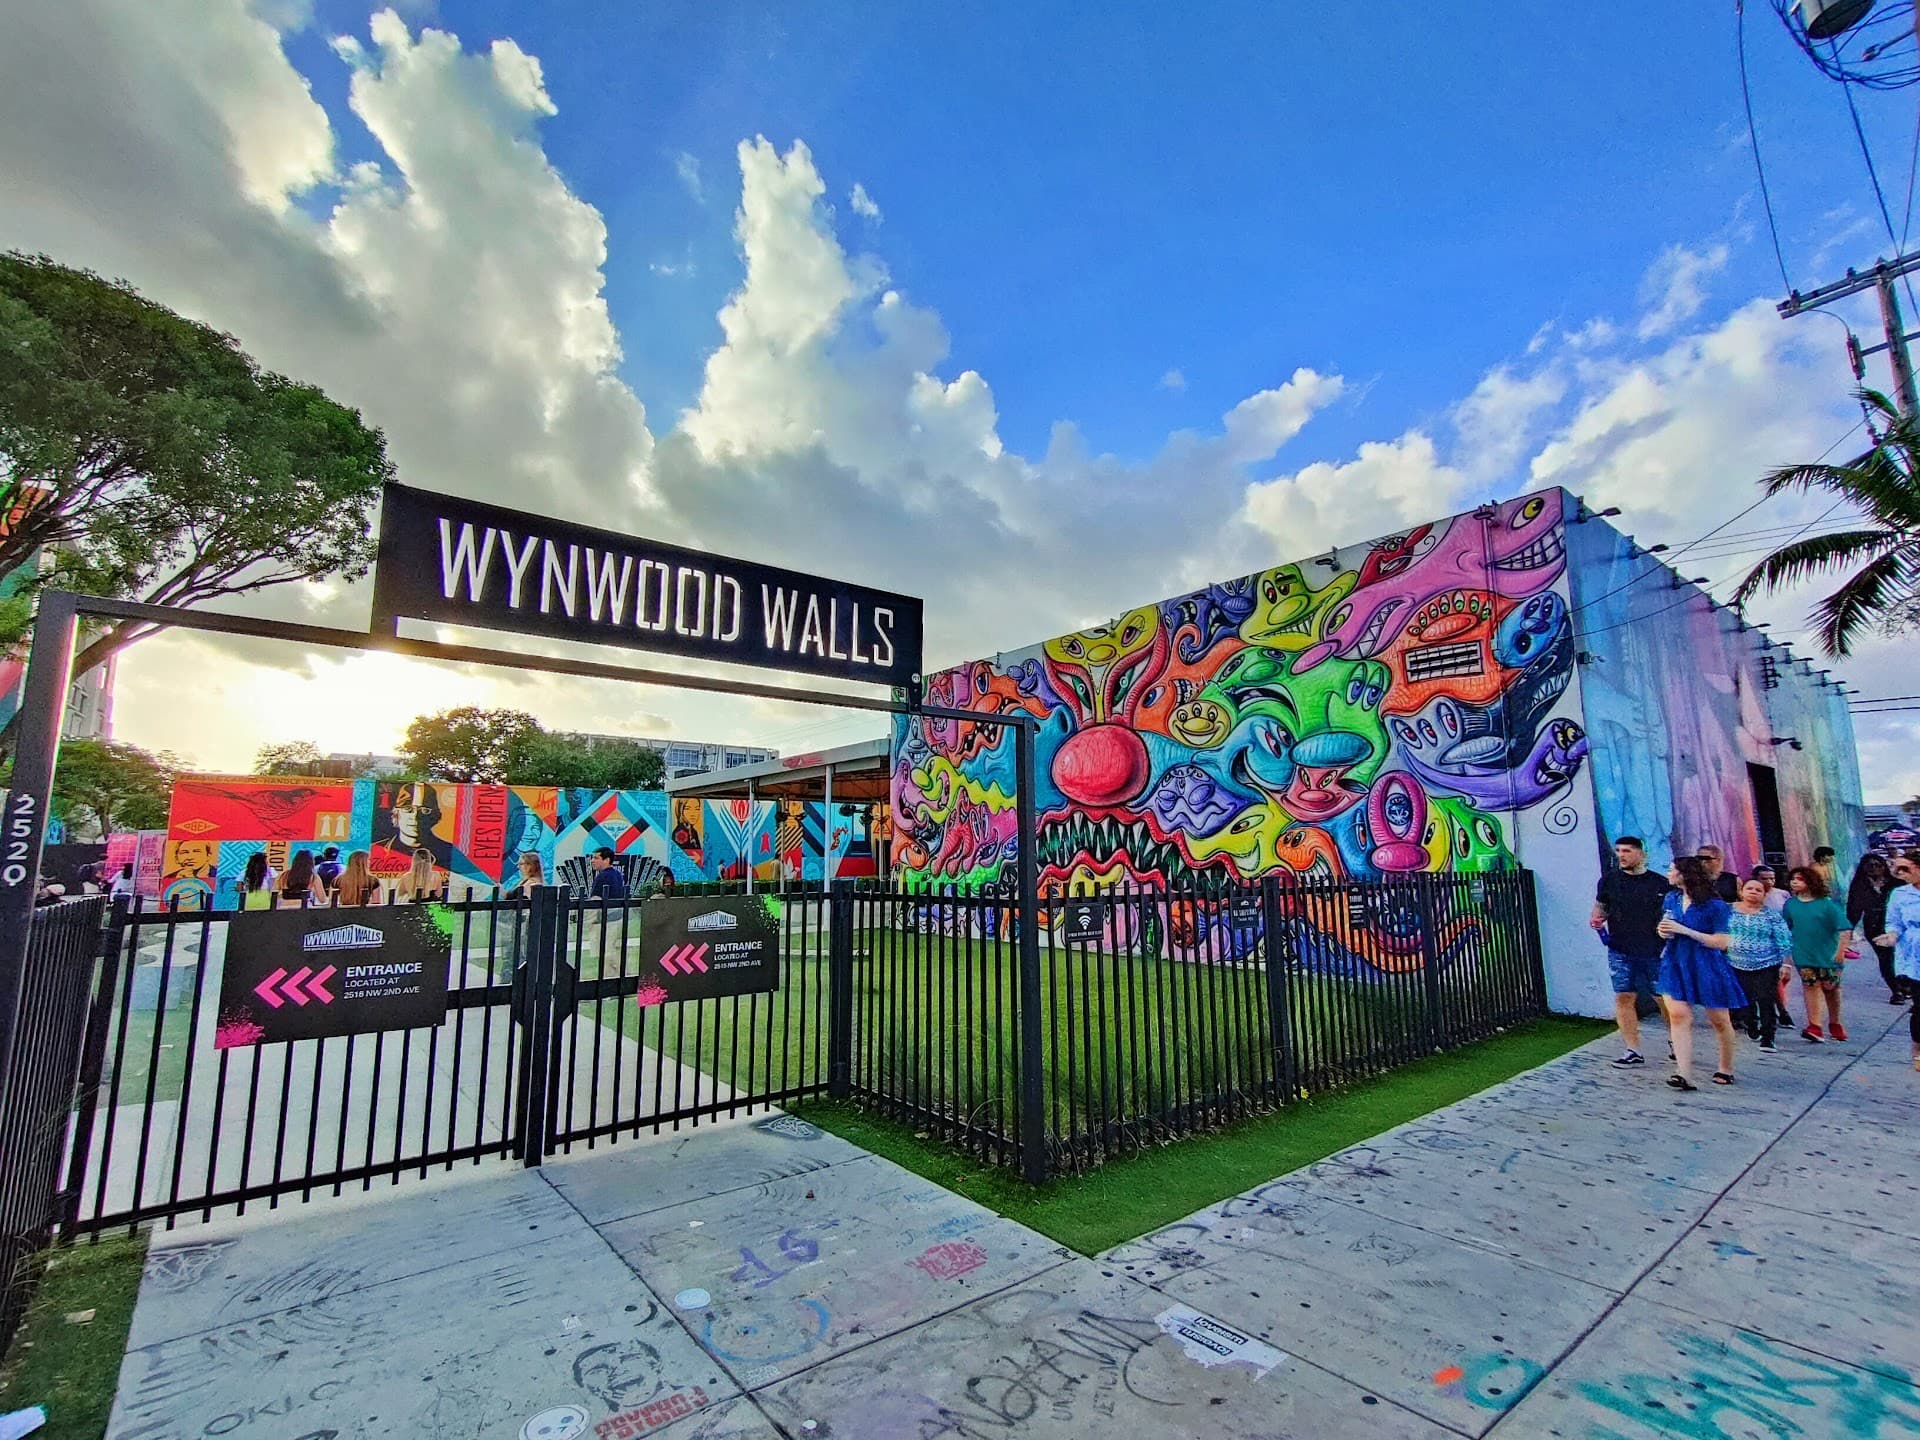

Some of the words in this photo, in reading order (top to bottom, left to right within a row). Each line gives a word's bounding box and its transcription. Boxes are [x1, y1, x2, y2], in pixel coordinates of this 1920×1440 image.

[437, 517, 742, 643] WYNWOOD
[761, 583, 895, 668] WALLS
[476, 786, 505, 823] OPEN
[3, 793, 36, 887] 2520
[474, 827, 502, 860] EYES
[305, 926, 353, 946] WYNWOOD
[355, 926, 382, 943] WALLS
[714, 941, 763, 953] ENTRANCE
[714, 952, 740, 961] LOCATED
[740, 951, 749, 959] AT
[750, 959, 762, 967] AVE
[346, 962, 423, 978] ENTRANCE
[345, 977, 386, 988] LOCATED
[387, 976, 400, 985] AT
[365, 988, 382, 998] NW
[383, 987, 402, 996] 2ND
[402, 985, 421, 995] AVE
